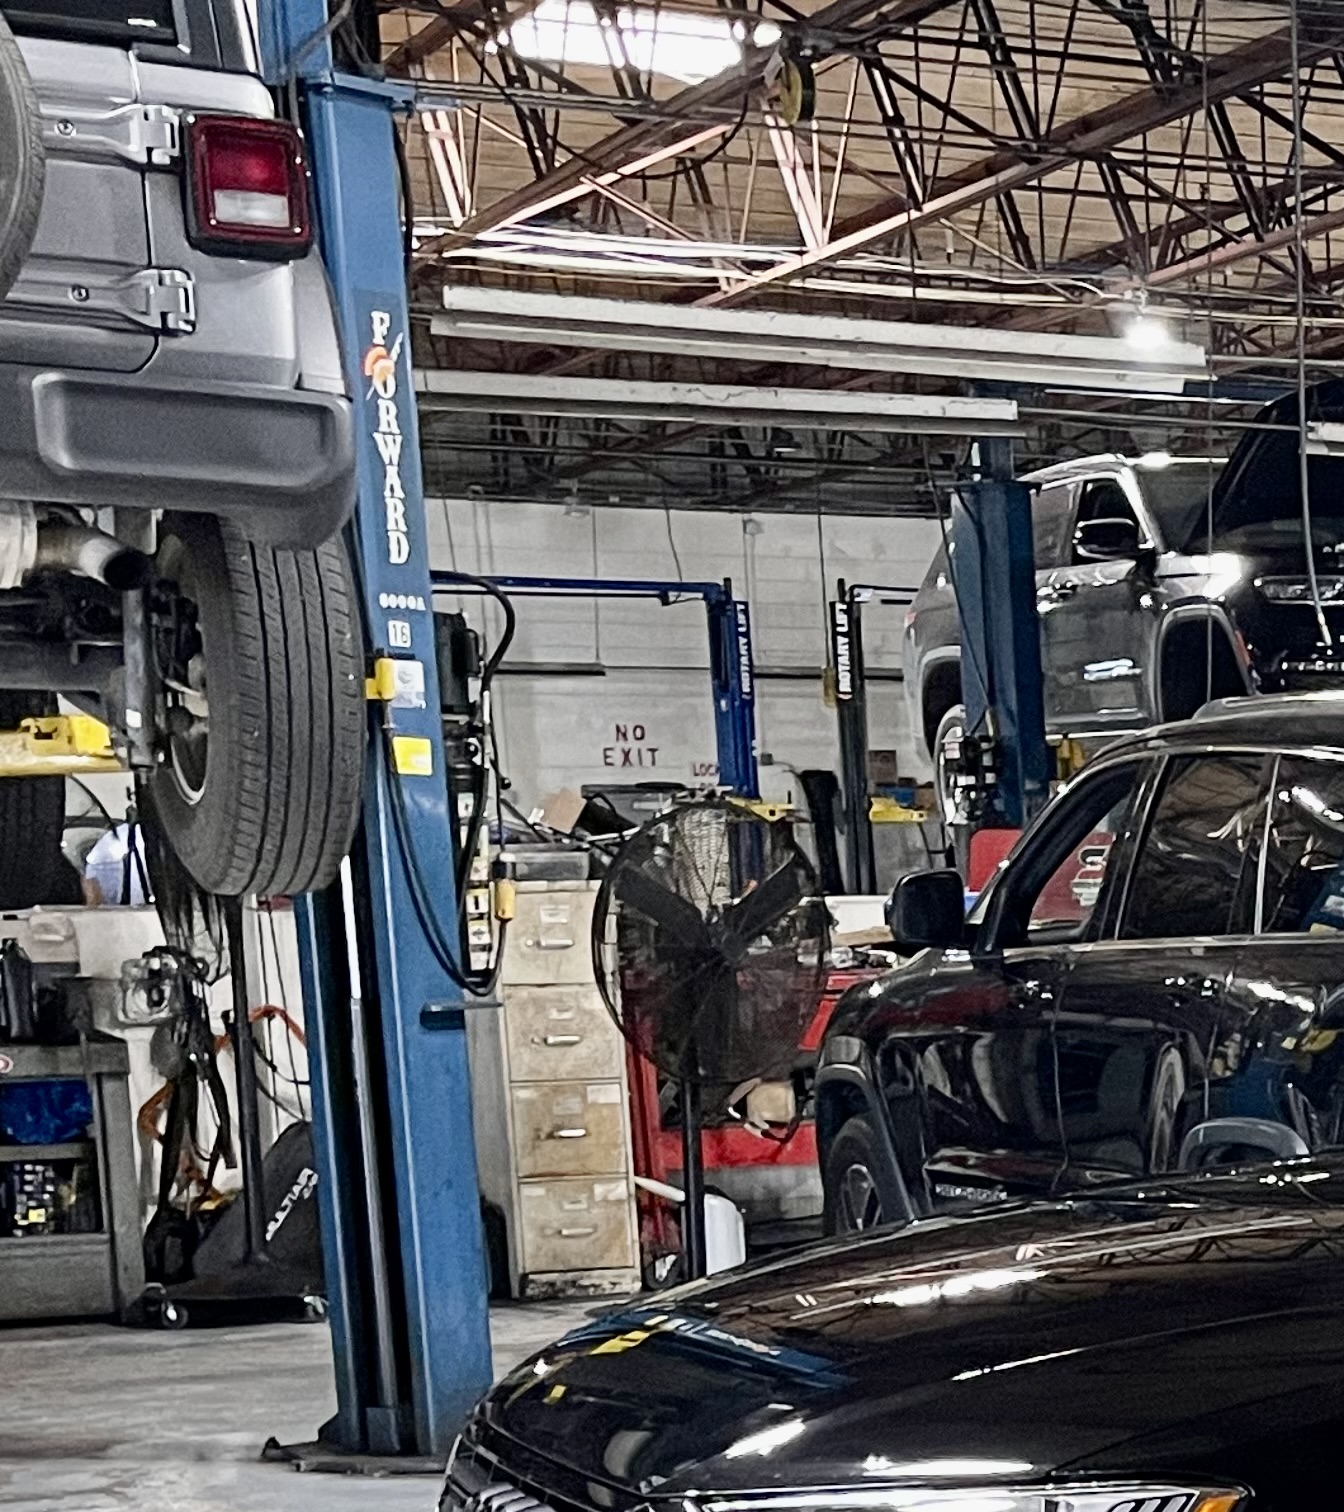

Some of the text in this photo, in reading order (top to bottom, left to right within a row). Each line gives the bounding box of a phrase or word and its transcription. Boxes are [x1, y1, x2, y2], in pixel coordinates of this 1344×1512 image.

[391, 623, 409, 645] 16
[615, 723, 646, 742] NO
[603, 747, 660, 767] EXIT
[692, 763, 717, 777] LOC
